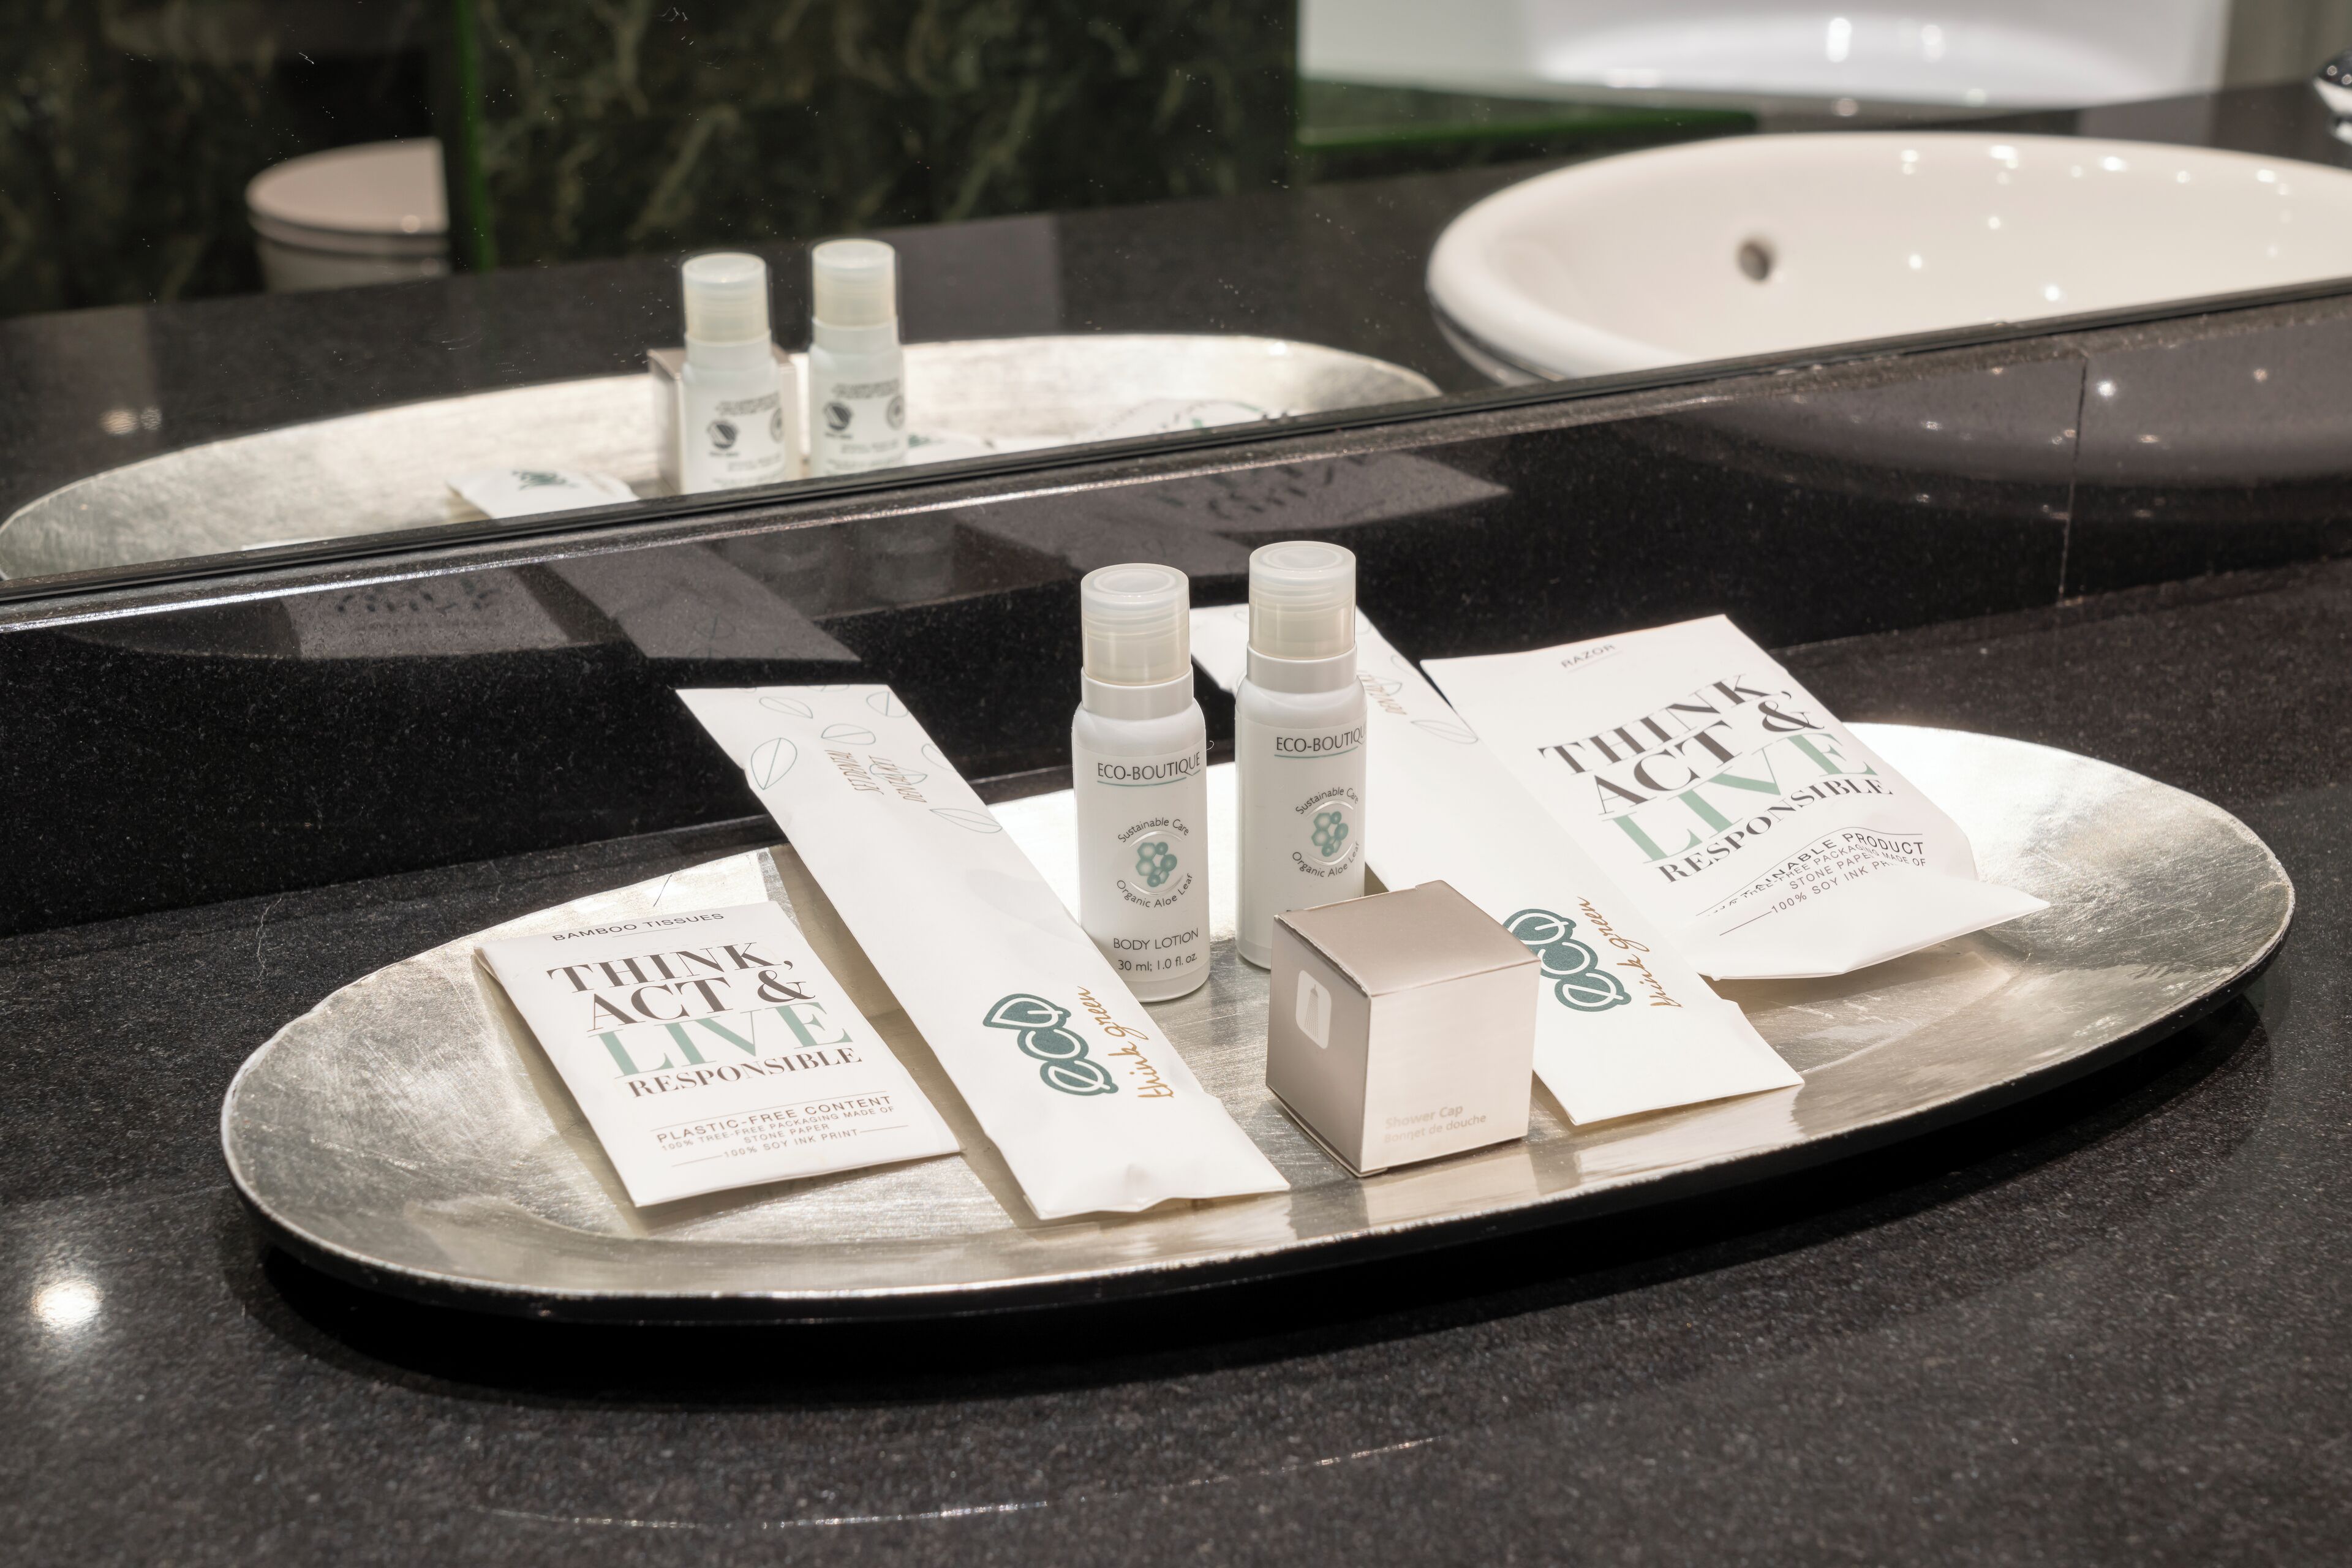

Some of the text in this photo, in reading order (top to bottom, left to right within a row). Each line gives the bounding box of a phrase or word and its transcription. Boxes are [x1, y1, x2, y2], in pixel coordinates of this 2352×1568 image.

[1561, 644, 1616, 668] RAZOR
[1537, 674, 1792, 775] THINK,
[1098, 752, 1200, 781] ECO-BOUTIQUE
[1592, 699, 1825, 815] ACT &
[1295, 786, 1359, 815] Sustainable Care
[1601, 732, 1879, 864] LIVE
[1118, 817, 1189, 843] Sustainable Care
[1654, 778, 1894, 884] RESPONSIBLE
[1842, 833, 1923, 854] PRODUCT
[1292, 842, 1360, 877] Organic Aloe Leaf
[1789, 865, 1834, 890] STONE
[1837, 852, 1873, 869] PAPE
[1913, 858, 1926, 867] OF
[1117, 873, 1193, 908] Organic Aloe Leaf
[1771, 892, 1807, 914] 100%
[1812, 876, 1839, 895] SOY
[1844, 865, 1869, 881] INK
[552, 913, 725, 941] BAMBOO TISSUES
[1114, 927, 1199, 950] BODY LOTION
[546, 941, 794, 993] THINK,
[1118, 960, 1132, 971] 30
[1136, 961, 1152, 971] ml;
[1158, 959, 1172, 970] 1.0
[1186, 953, 1197, 963] oz.
[1577, 896, 1683, 1008] think green
[587, 970, 816, 1031] ACT &
[587, 1001, 854, 1079] LIVE
[1077, 986, 1174, 1099] think green
[627, 1047, 862, 1098] RESPONSIBLE
[657, 1096, 892, 1143] PLASTIC-FREE CONTENT
[662, 1139, 693, 1151] 100%
[699, 1125, 764, 1142] TREE-FREE
[770, 1114, 839, 1129] PACKAGING
[843, 1107, 876, 1118] MADE
[744, 1123, 830, 1144] STONE PAPER
[1384, 1115, 1487, 1143] Bonnet de douche
[1385, 1106, 1463, 1129] Shower Cap
[723, 1129, 858, 1158] 100% SOY INK PRINT
